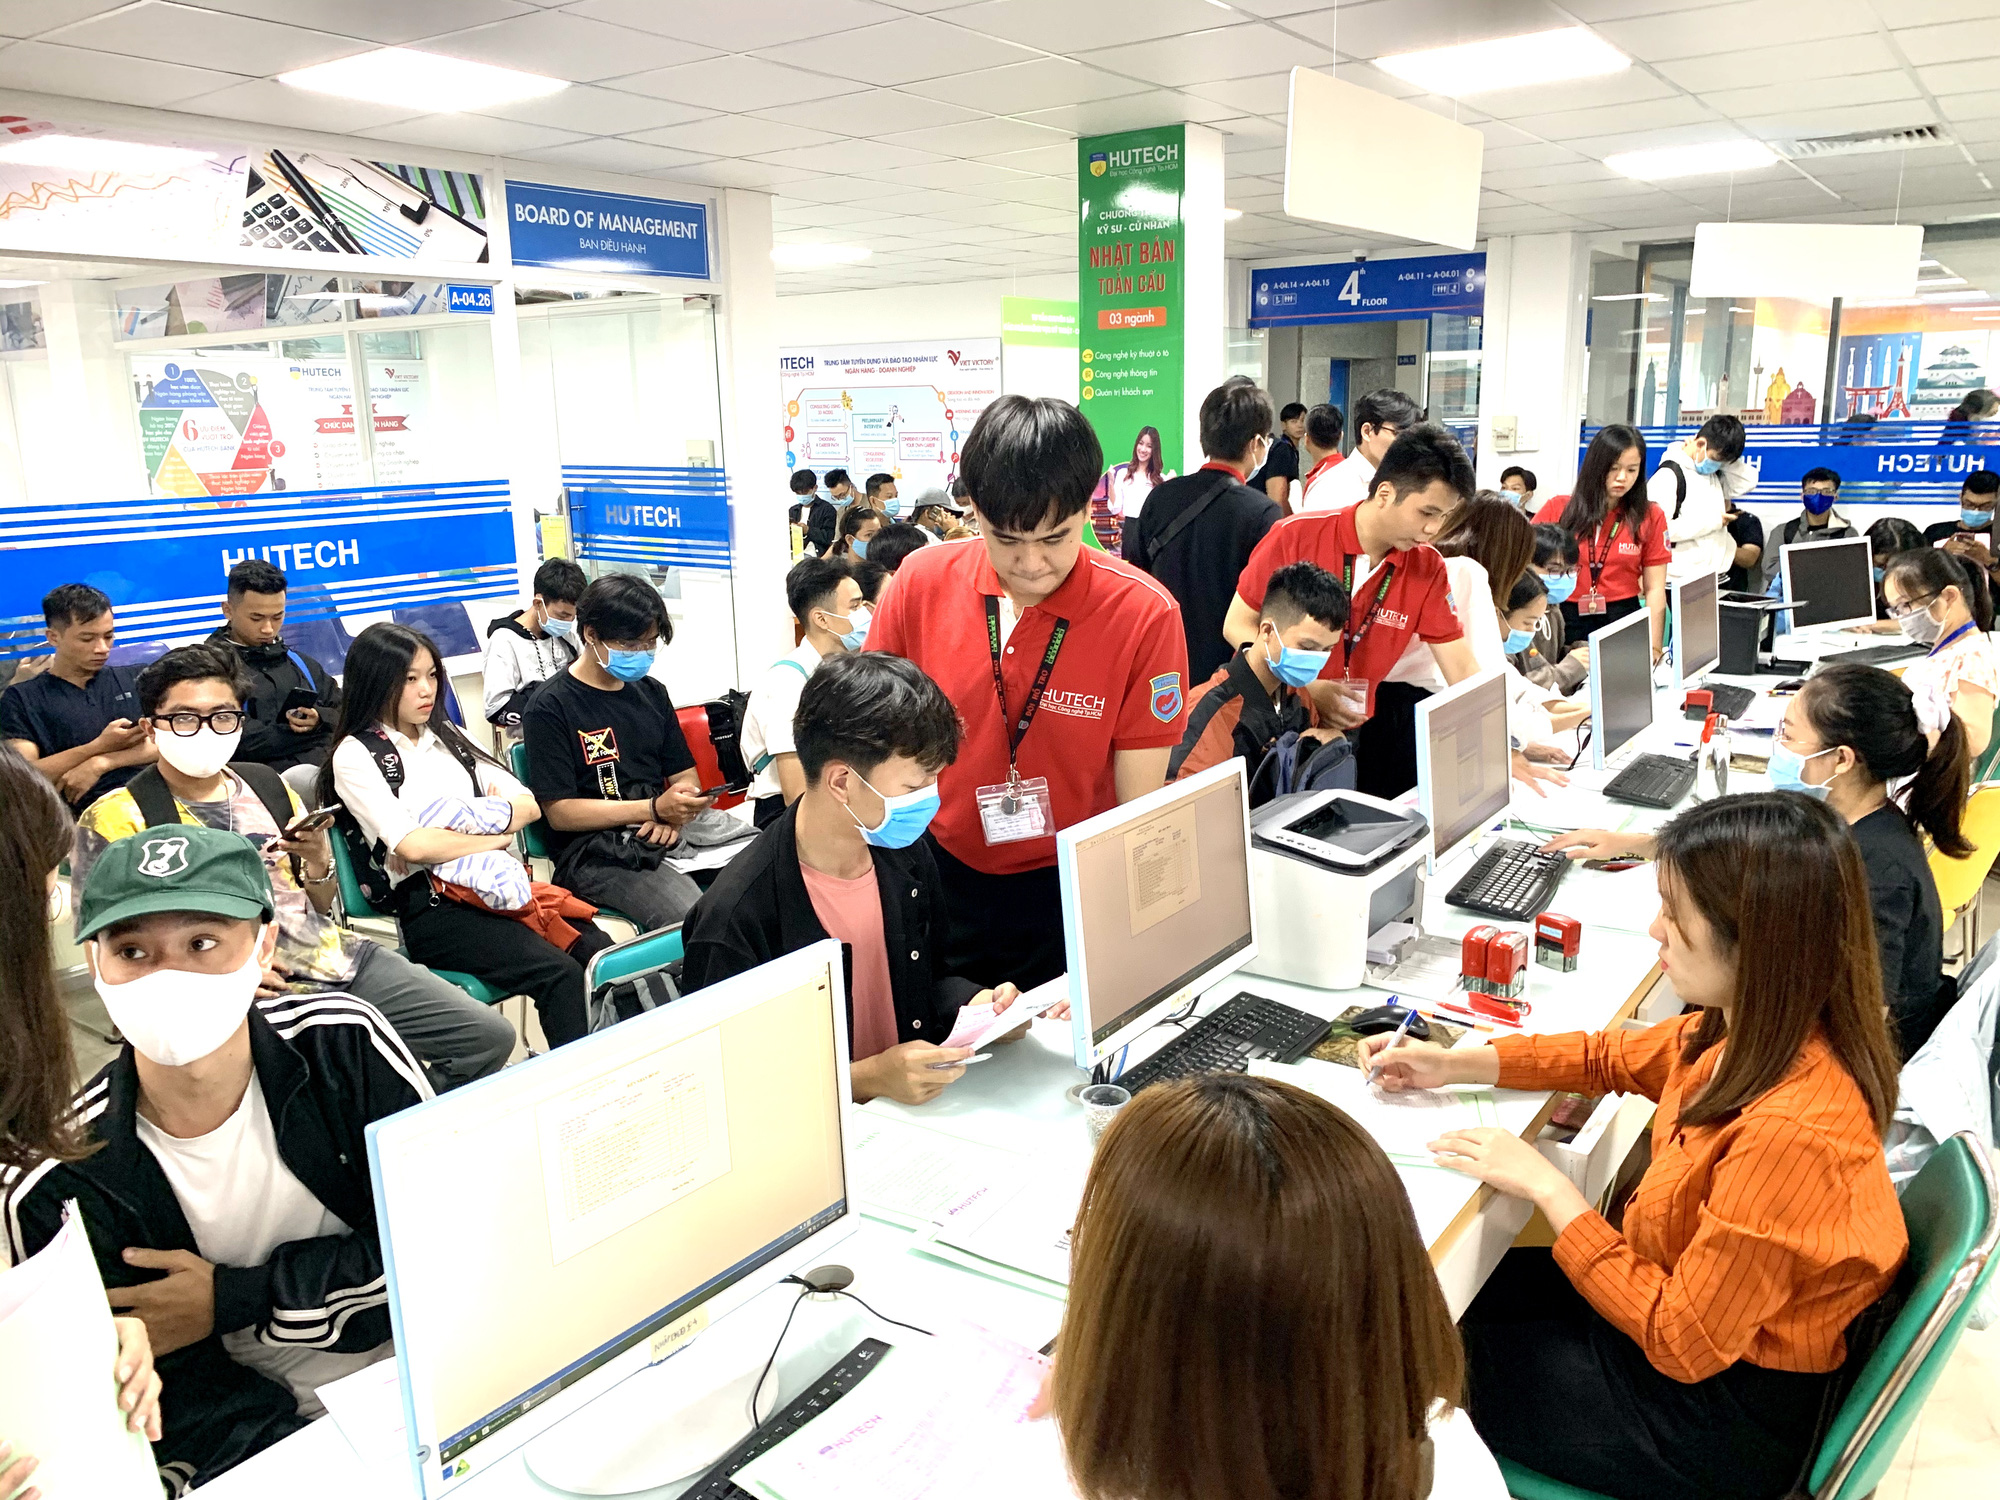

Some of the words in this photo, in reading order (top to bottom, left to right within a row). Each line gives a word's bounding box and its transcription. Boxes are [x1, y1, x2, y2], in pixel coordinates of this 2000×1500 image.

[1109, 144, 1178, 168] HUTECH
[514, 203, 570, 226] BOARD
[574, 209, 594, 229] OF
[599, 212, 698, 240] MANAGEMENT
[579, 237, 599, 250] BAN
[600, 238, 619, 252] ĐIỀU
[620, 239, 647, 254] HÀNH
[1089, 240, 1133, 270] NHẬT
[1140, 235, 1175, 265] BẢN
[1398, 272, 1424, 281] A-04.11
[1433, 270, 1460, 279] A-04.01
[1097, 272, 1133, 296] TOÀN
[1137, 269, 1166, 292] CẦU
[1273, 281, 1298, 290] A-04.14
[1305, 279, 1330, 288] A-04.15
[1337, 270, 1361, 306] 4
[451, 291, 490, 308] A-04.26
[1362, 297, 1388, 307] FLOOR
[1109, 313, 1122, 325] 03
[1124, 310, 1155, 327] ngành
[824, 358, 840, 367] TRUNG
[840, 357, 851, 366] TÂM
[851, 356, 866, 366] TUYỂN
[867, 357, 881, 367] DỤNG
[901, 356, 912, 365] TẠO
[913, 355, 928, 364] NHÂN
[1095, 351, 1112, 362] Công
[1113, 351, 1128, 362] nghệ
[1129, 350, 1138, 360] kỹ
[1138, 349, 1156, 359] thuật
[1156, 350, 1162, 358] ô
[1162, 349, 1169, 357] tô
[302, 368, 342, 377] HUTECH
[845, 366, 859, 375] NGÂN
[860, 366, 875, 374] HÀNG
[897, 365, 916, 374] NGHIỆP
[1095, 370, 1112, 380] Công
[1113, 370, 1128, 380] nghệ
[1129, 369, 1148, 379] thông
[1149, 369, 1158, 377] tin
[241, 377, 248, 386] 2
[1095, 388, 1112, 397] Quản
[1113, 389, 1121, 398] trị
[1121, 387, 1141, 396] khách
[1142, 388, 1153, 397] sạn
[182, 419, 199, 442] 6
[342, 421, 355, 429] DAN
[275, 445, 281, 454] 3
[605, 503, 681, 528] HUTECH
[1041, 688, 1106, 710] HUTECH
